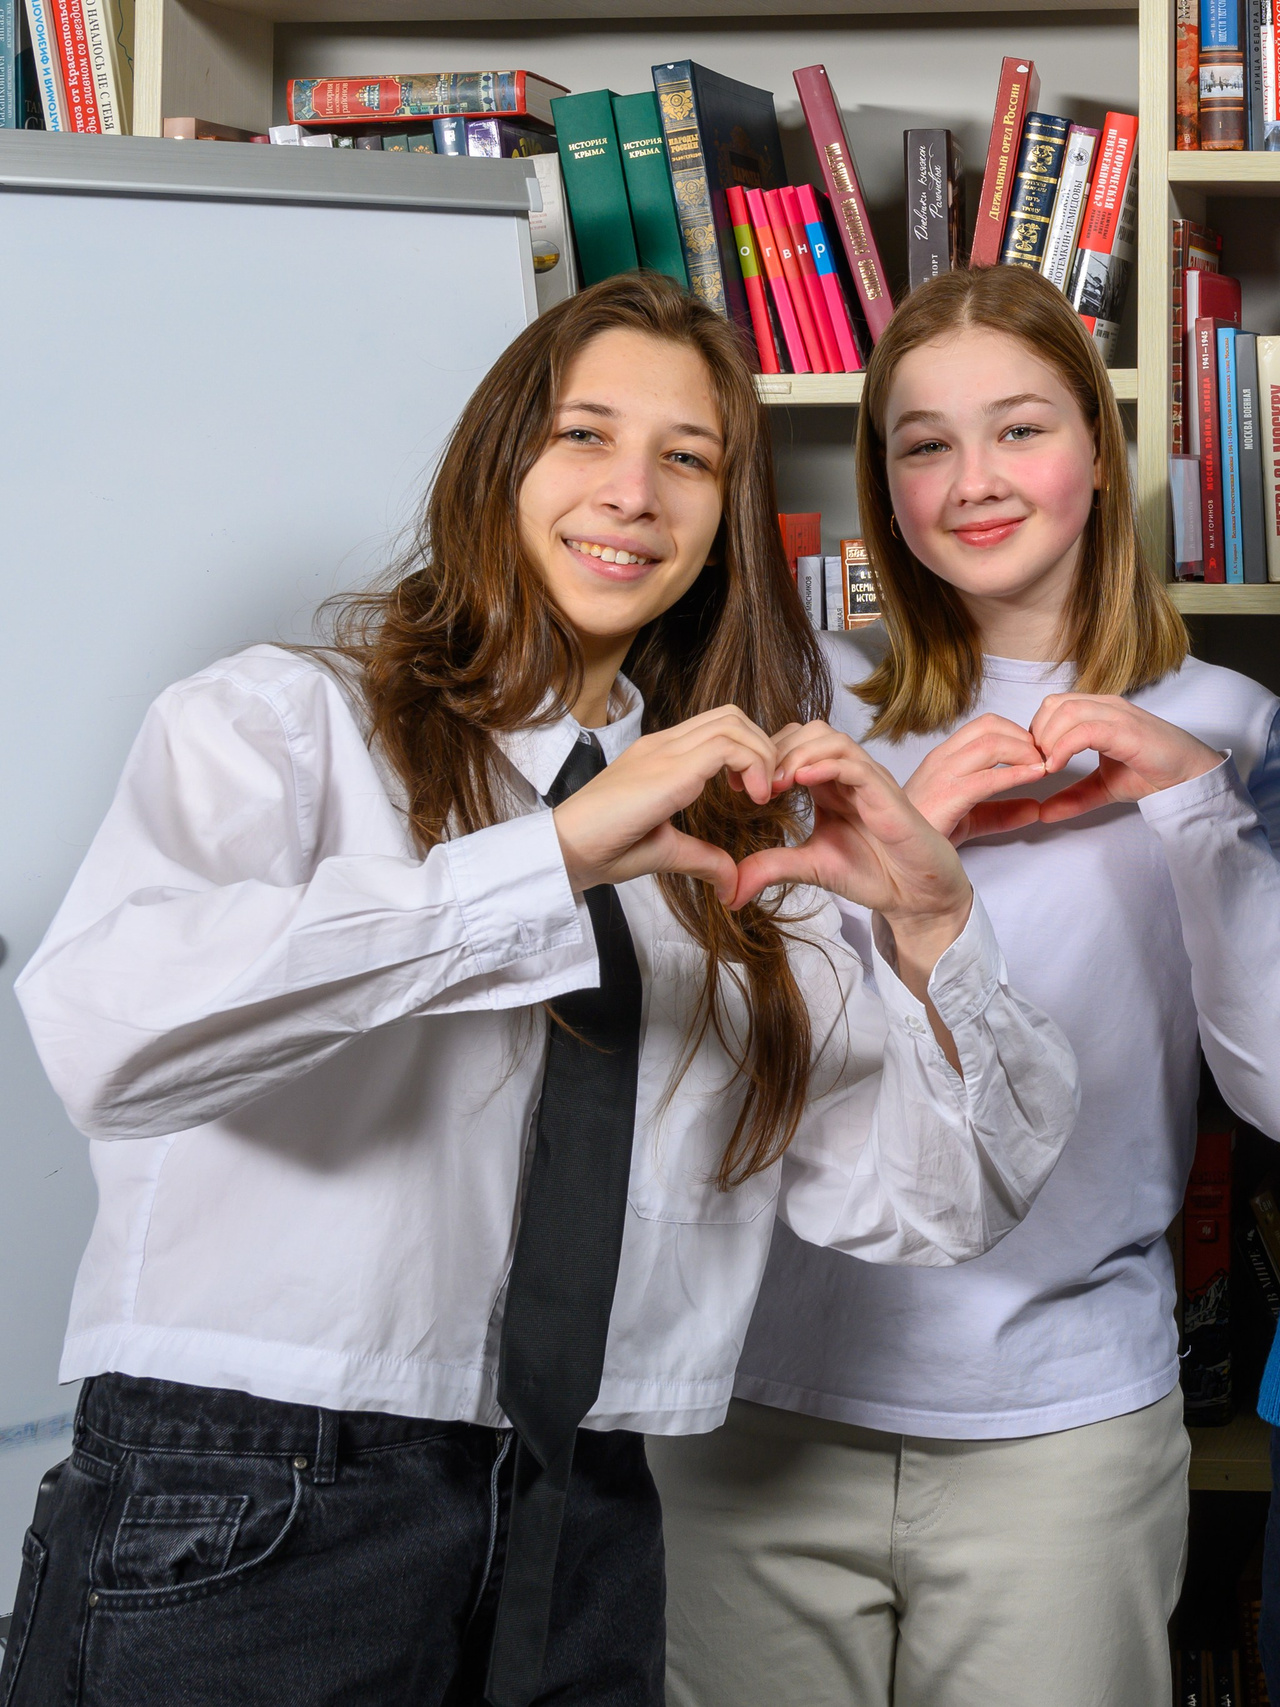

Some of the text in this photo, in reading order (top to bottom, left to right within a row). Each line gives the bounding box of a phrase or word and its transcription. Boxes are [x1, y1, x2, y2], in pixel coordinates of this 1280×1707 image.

[1252, 11, 1262, 92] УЛИЦА ФЕДОРА
[340, 82, 351, 114] районов
[568, 137, 608, 152] ИСТОРИЯ
[573, 147, 606, 160] КРЫМА
[622, 137, 663, 151] ИСТОРИЯ
[628, 147, 661, 159] КРЫМА
[989, 83, 1021, 222] ДЕРЖАВНЫЙ ОРЕЛ РОССИИ
[1092, 128, 1118, 208] НЕИЗБЕЖНОСТЬ?
[1104, 137, 1129, 210] ИСТОРИЧЕСКАЯ
[1053, 234, 1072, 286] ПОТЕМКИН
[1064, 179, 1084, 232] ДЕМИДОВЫ
[1242, 389, 1254, 450] МОСКВА ВОЕННАЯ
